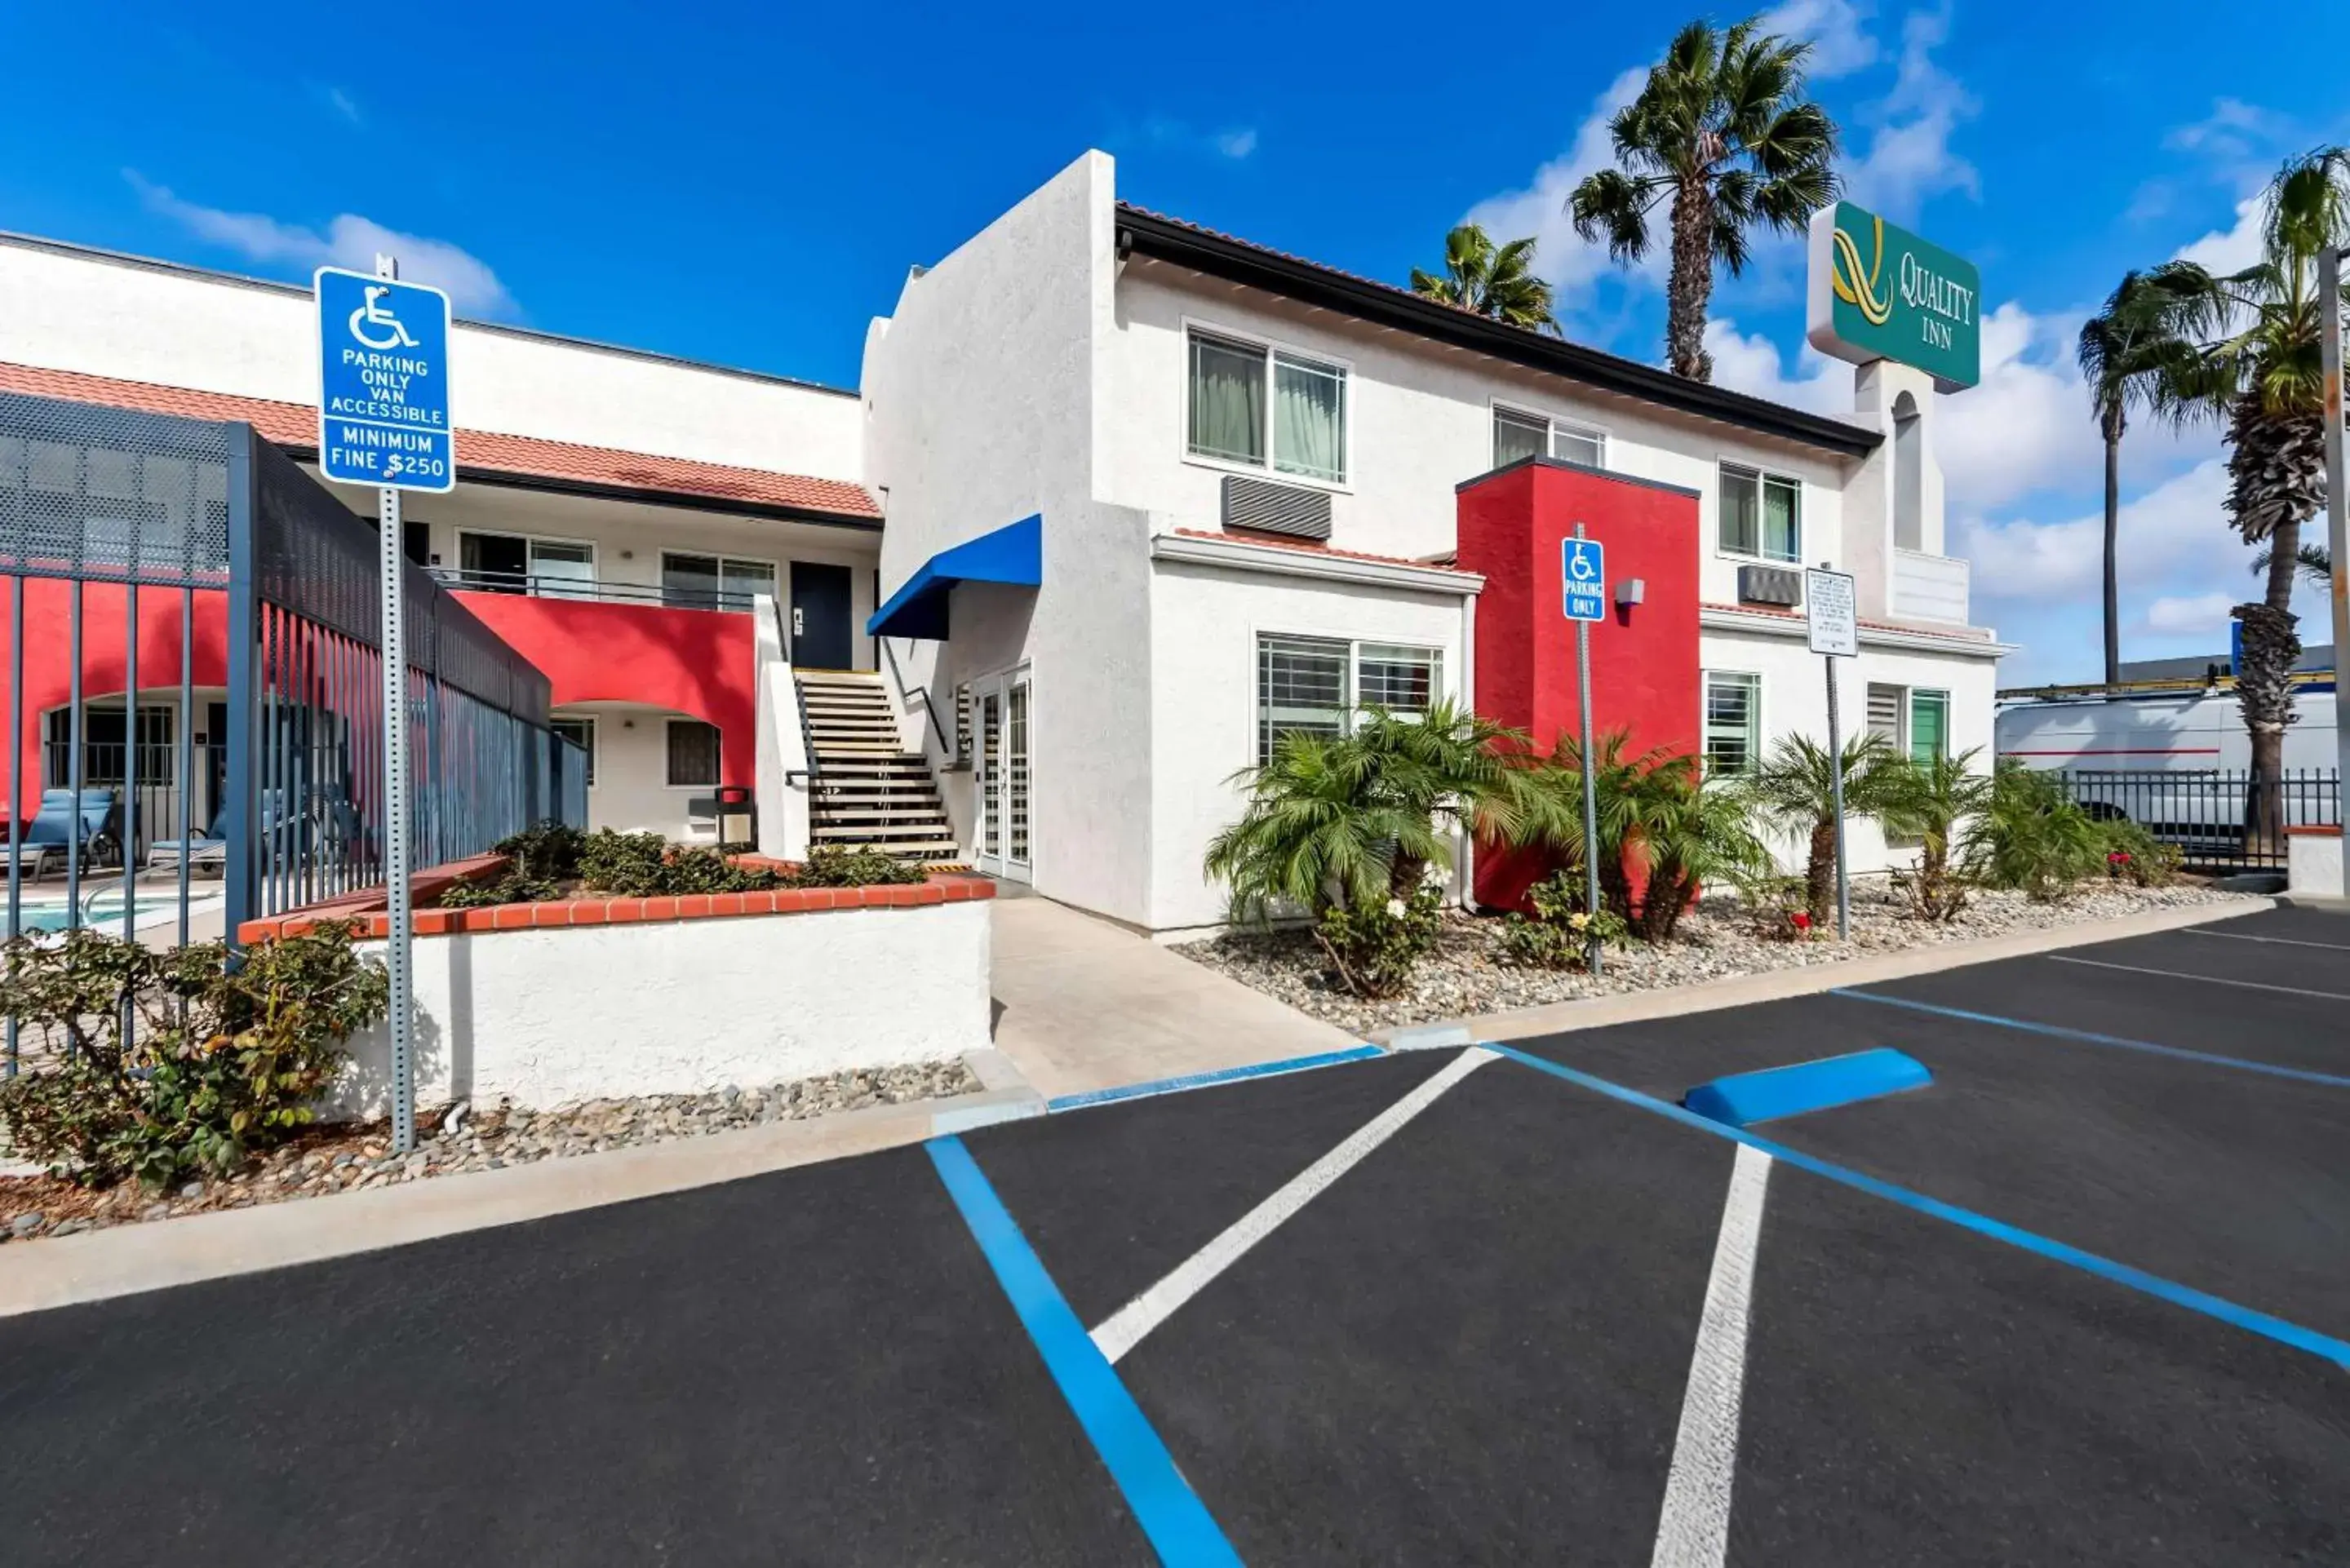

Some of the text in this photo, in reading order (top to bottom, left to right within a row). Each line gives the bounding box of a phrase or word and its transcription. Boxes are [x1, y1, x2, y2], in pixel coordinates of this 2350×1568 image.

[1901, 252, 1973, 326] QUALITY
[1922, 317, 1952, 352] INN
[343, 349, 428, 376] PARKING
[361, 369, 410, 390] ONLY
[370, 387, 405, 404] VAN
[332, 397, 442, 424] ACCESSIBLE
[344, 427, 432, 453] MINIMUM
[331, 448, 444, 477] FINE $250
[1567, 579, 1603, 598] PARKING
[1572, 597, 1596, 615] ONLY
